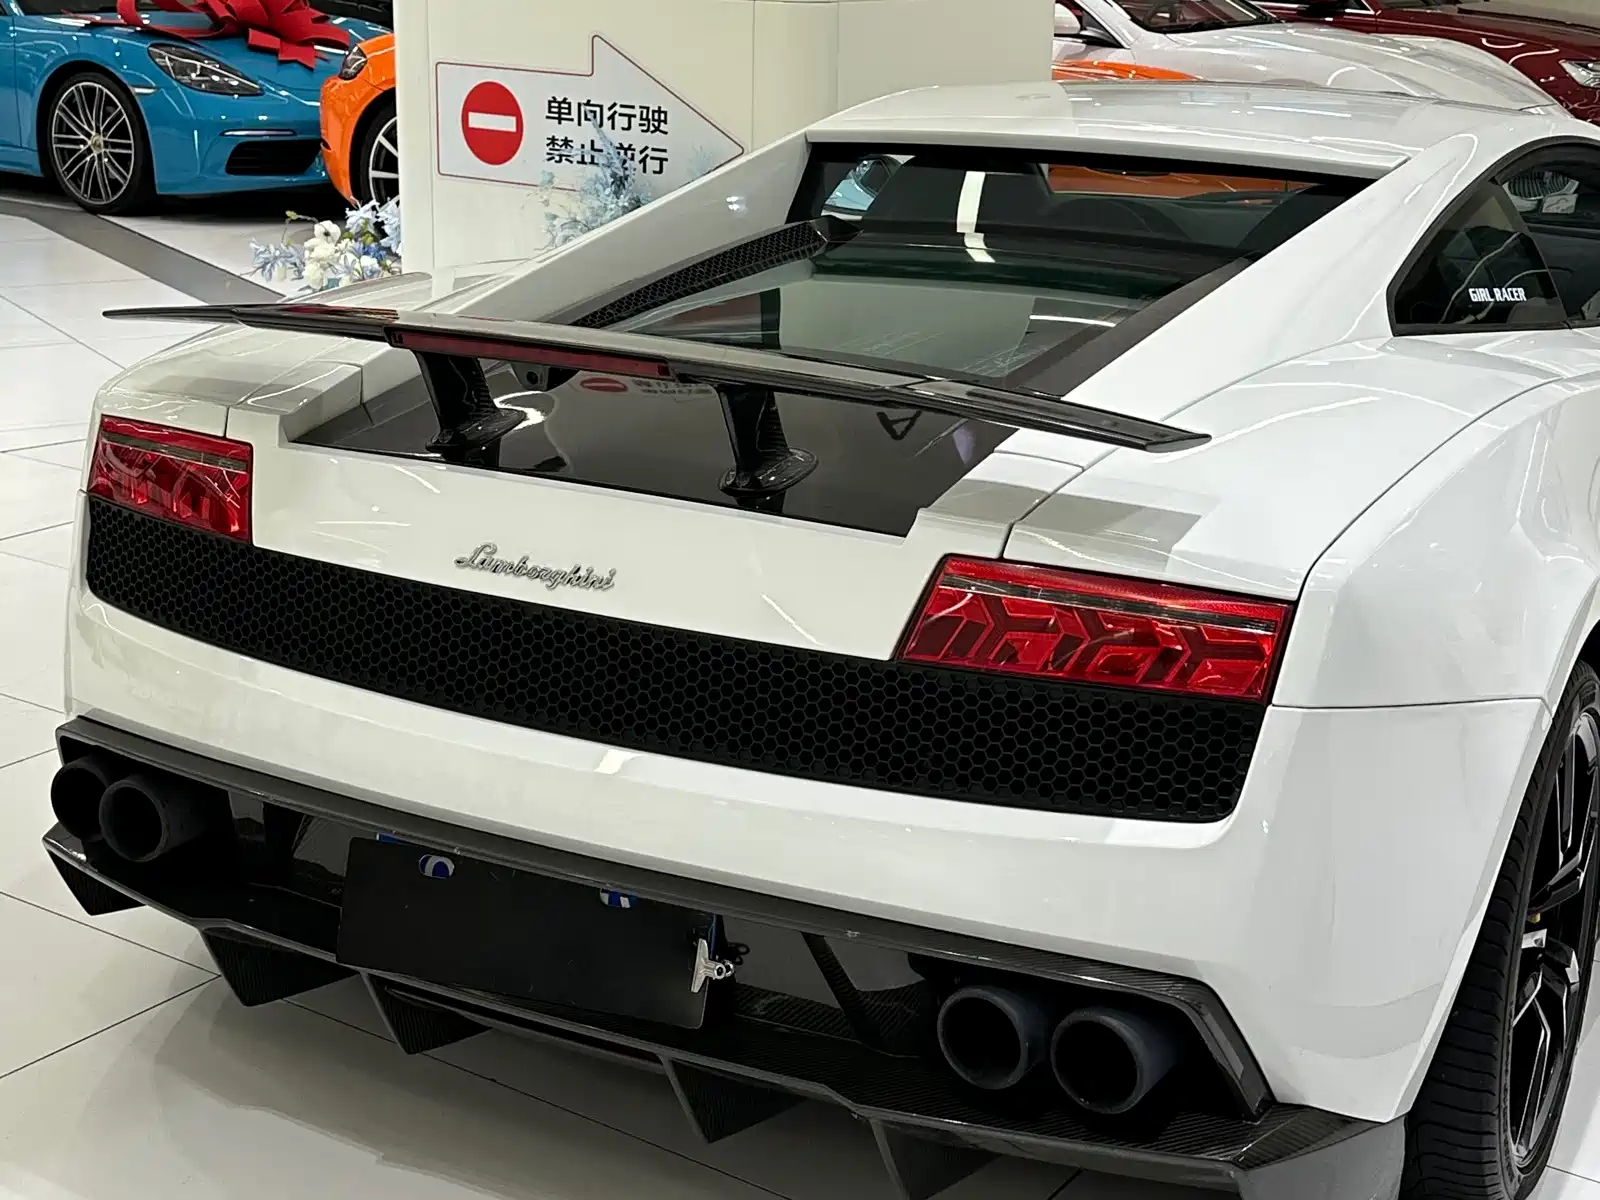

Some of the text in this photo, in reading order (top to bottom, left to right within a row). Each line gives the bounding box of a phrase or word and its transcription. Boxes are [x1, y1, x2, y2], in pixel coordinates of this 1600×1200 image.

[545, 96, 669, 135] 单向行驶
[1468, 287, 1527, 302] GIRL RACER
[454, 542, 617, 591] Lamborghini
